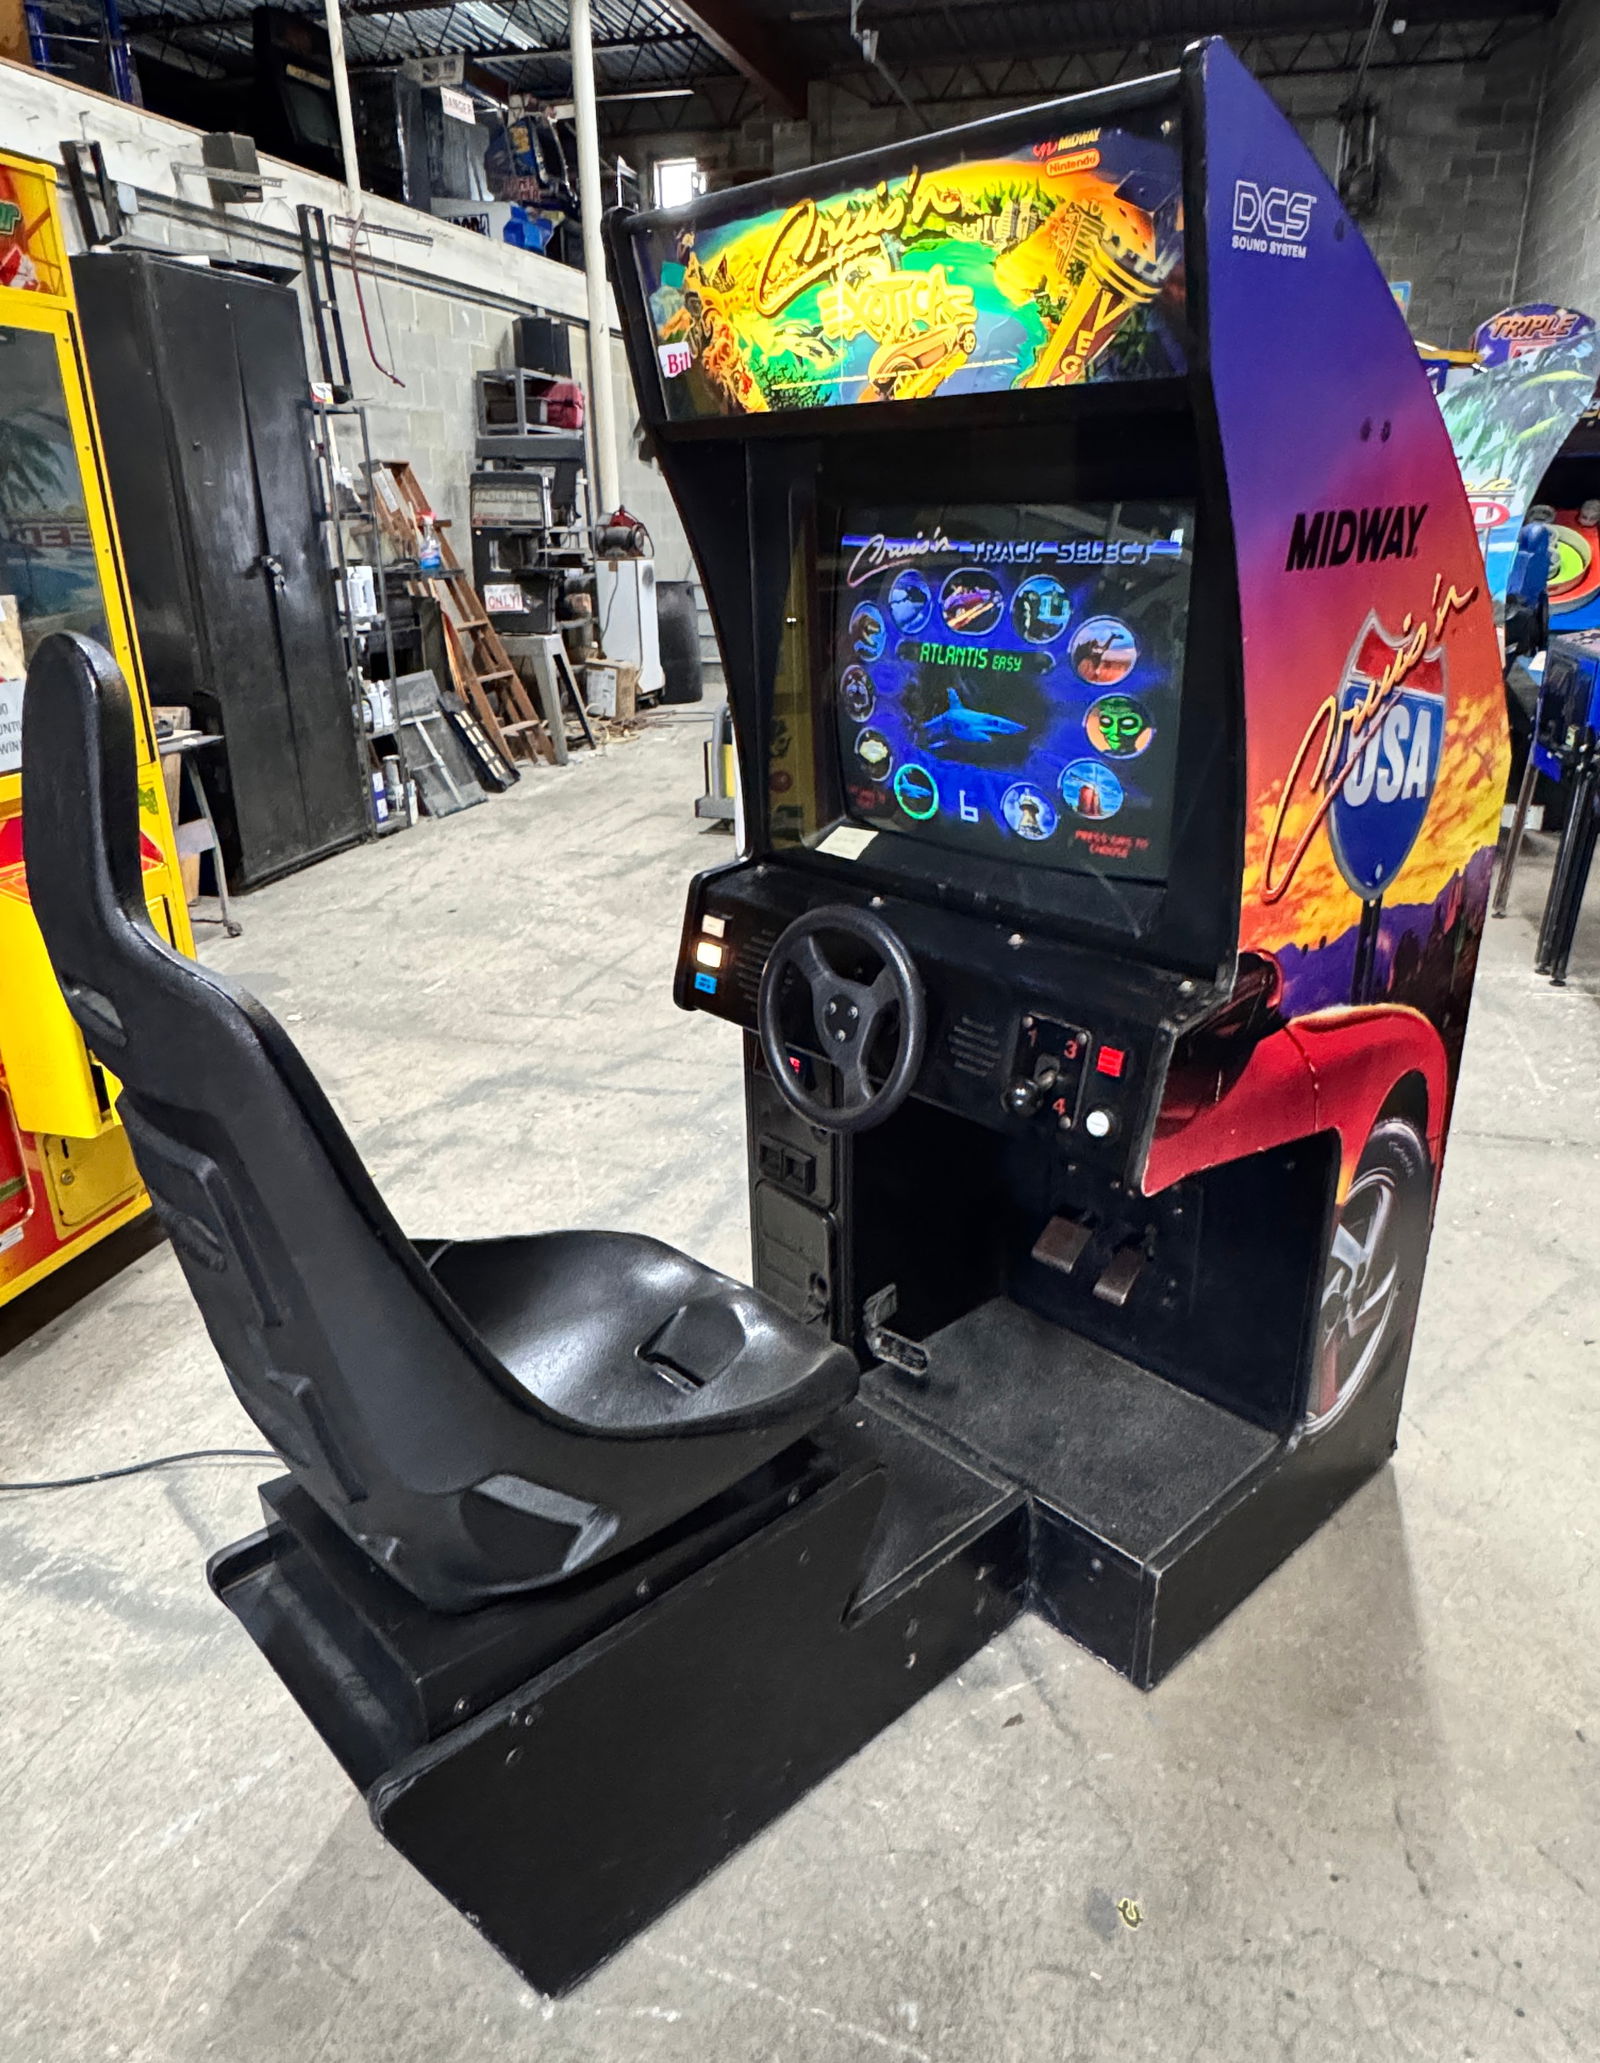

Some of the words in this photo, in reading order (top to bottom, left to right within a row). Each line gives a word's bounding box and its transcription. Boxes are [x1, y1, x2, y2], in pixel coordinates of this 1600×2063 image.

[1058, 127, 1102, 151] MIDWAY
[1049, 154, 1097, 173] Nintendo
[1232, 180, 1310, 241] DCS
[1232, 235, 1268, 253] SOUND
[1269, 241, 1307, 258] SYSTEM
[1491, 315, 1579, 339] TRIPLE
[1284, 504, 1429, 572] MIDWAY
[971, 540, 1043, 564] TRACK
[1055, 541, 1151, 565] SELECT
[919, 642, 989, 669] ATLANTIS
[991, 655, 1022, 673] EASY
[1343, 698, 1433, 807] USA
[1027, 1028, 1038, 1048] 1
[1063, 1039, 1078, 1060] 3
[1052, 1097, 1066, 1116] 4
